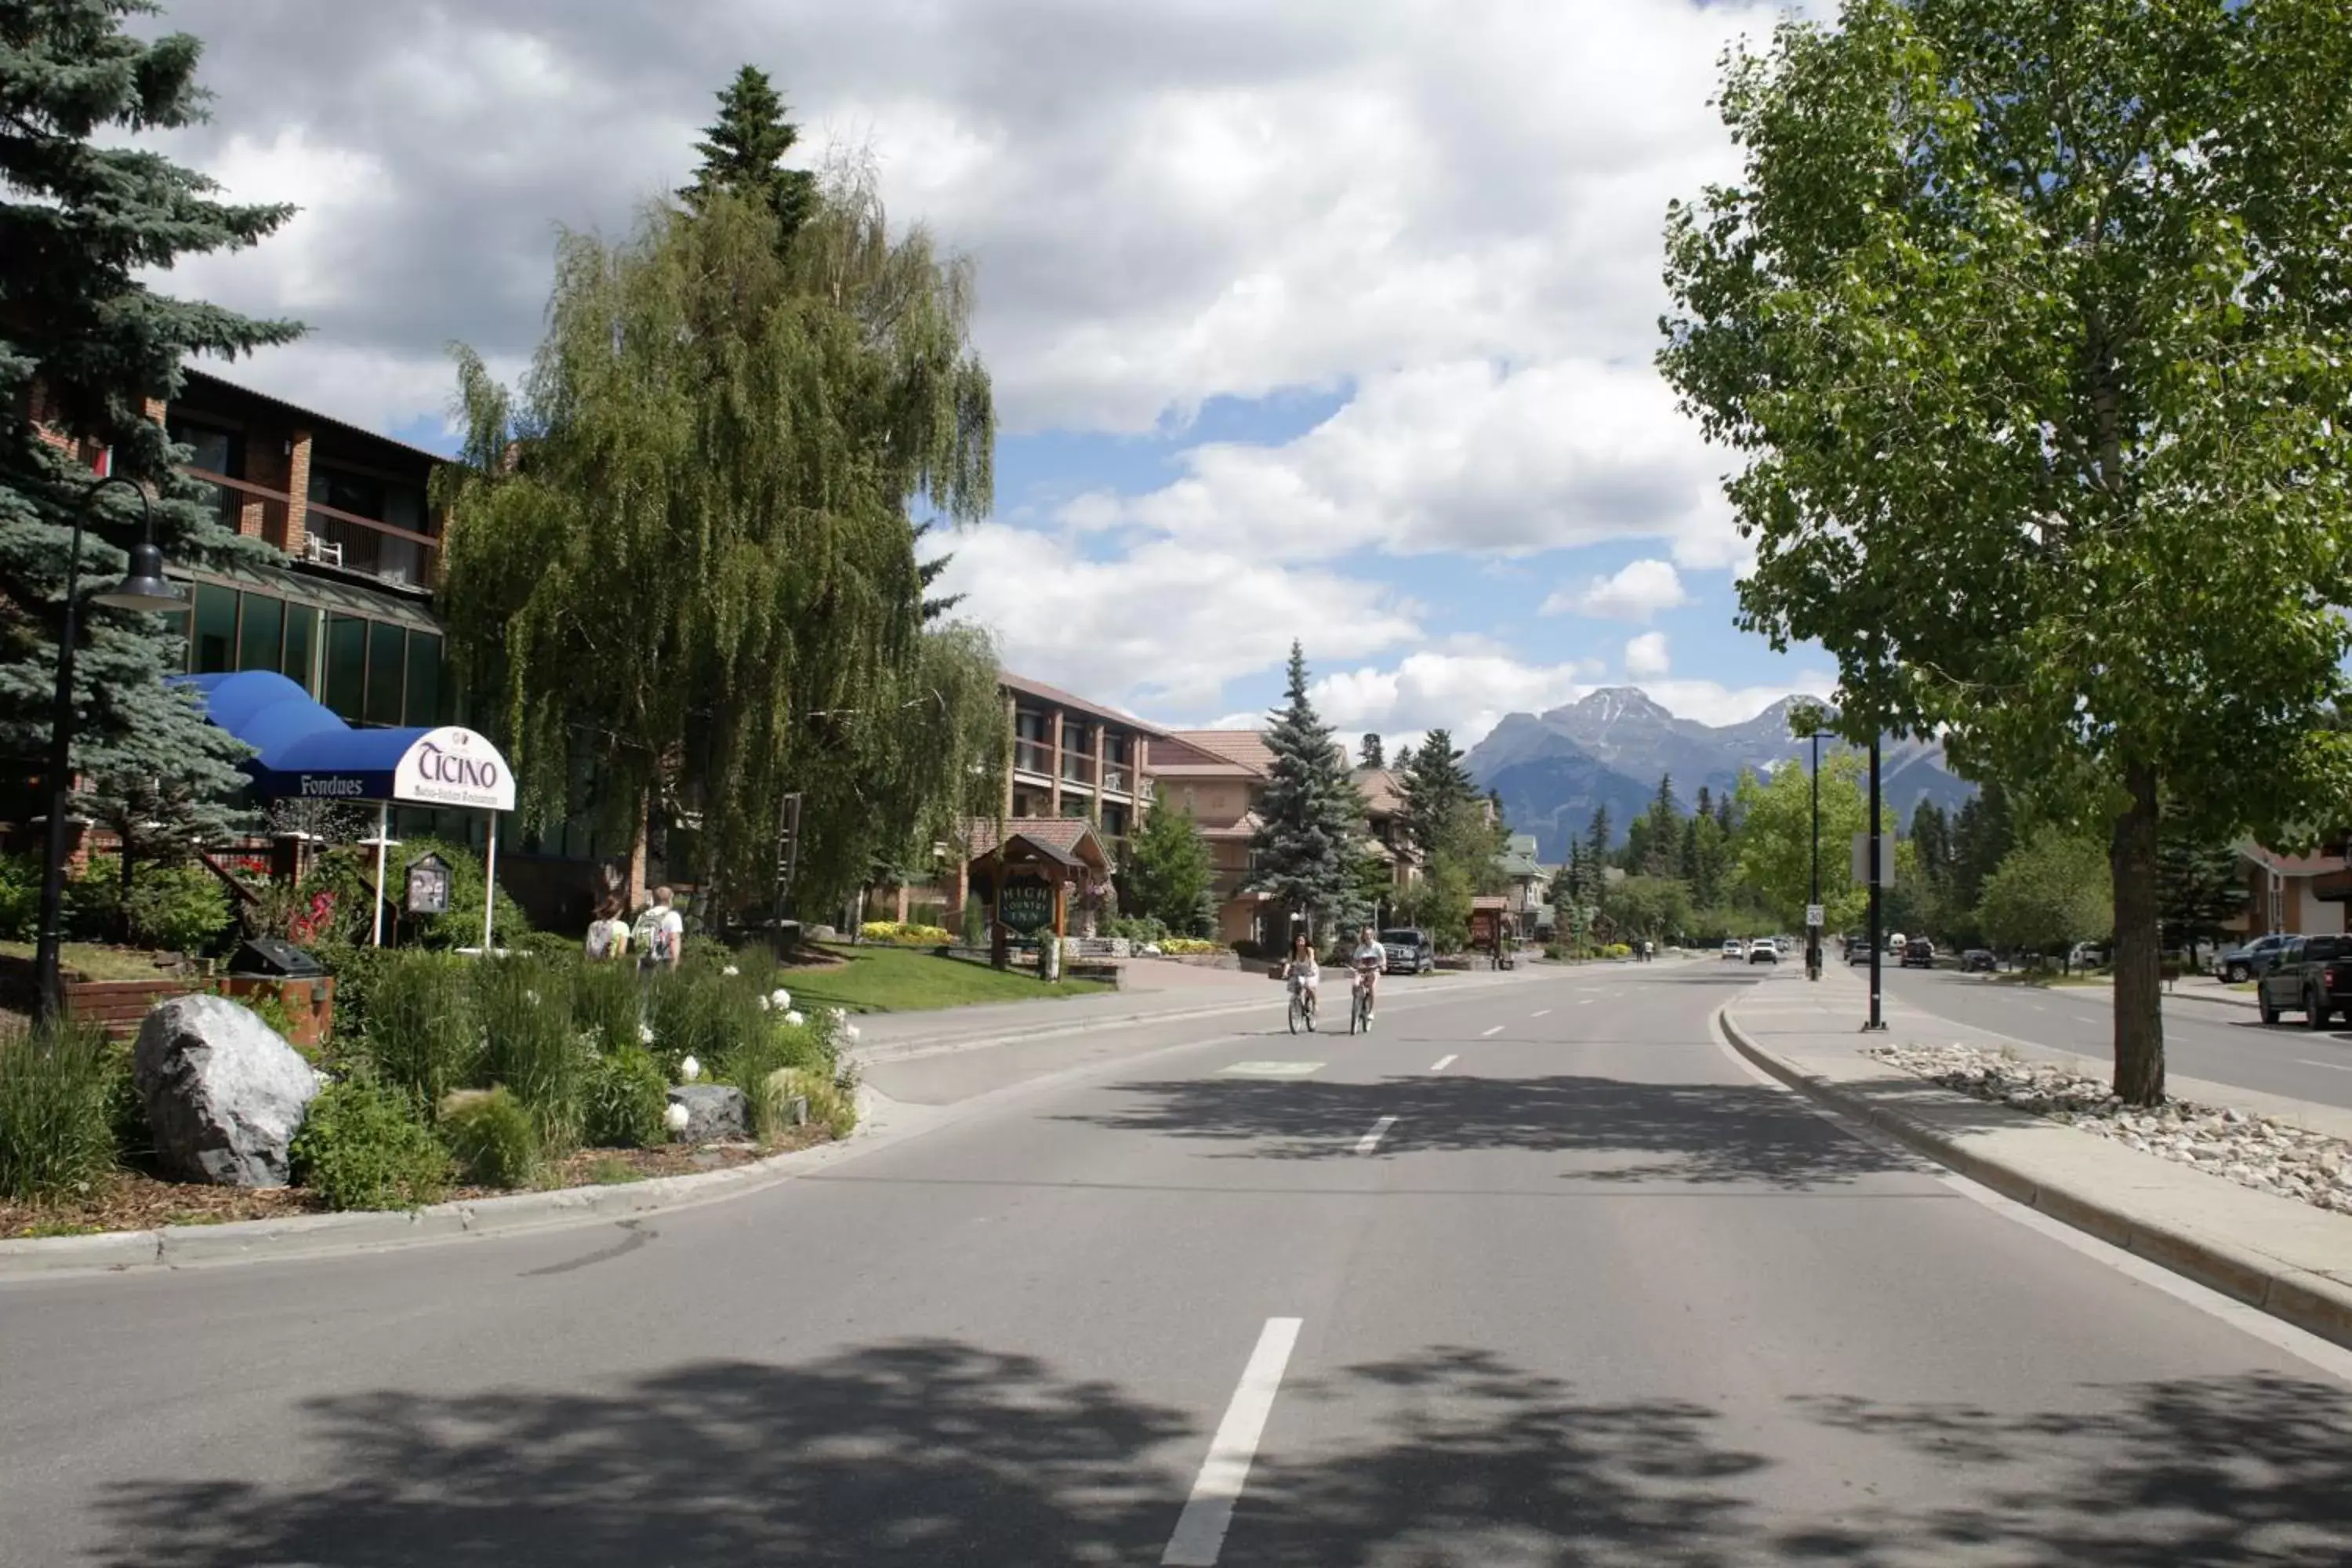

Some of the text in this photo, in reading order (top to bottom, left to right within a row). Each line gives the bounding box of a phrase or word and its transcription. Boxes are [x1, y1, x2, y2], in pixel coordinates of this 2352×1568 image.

[419, 742, 497, 789] TICINO
[300, 775, 364, 795] Fondues
[1004, 887, 1047, 900] HIGH
[1011, 912, 1039, 921] INN
[1809, 912, 1820, 923] 30
